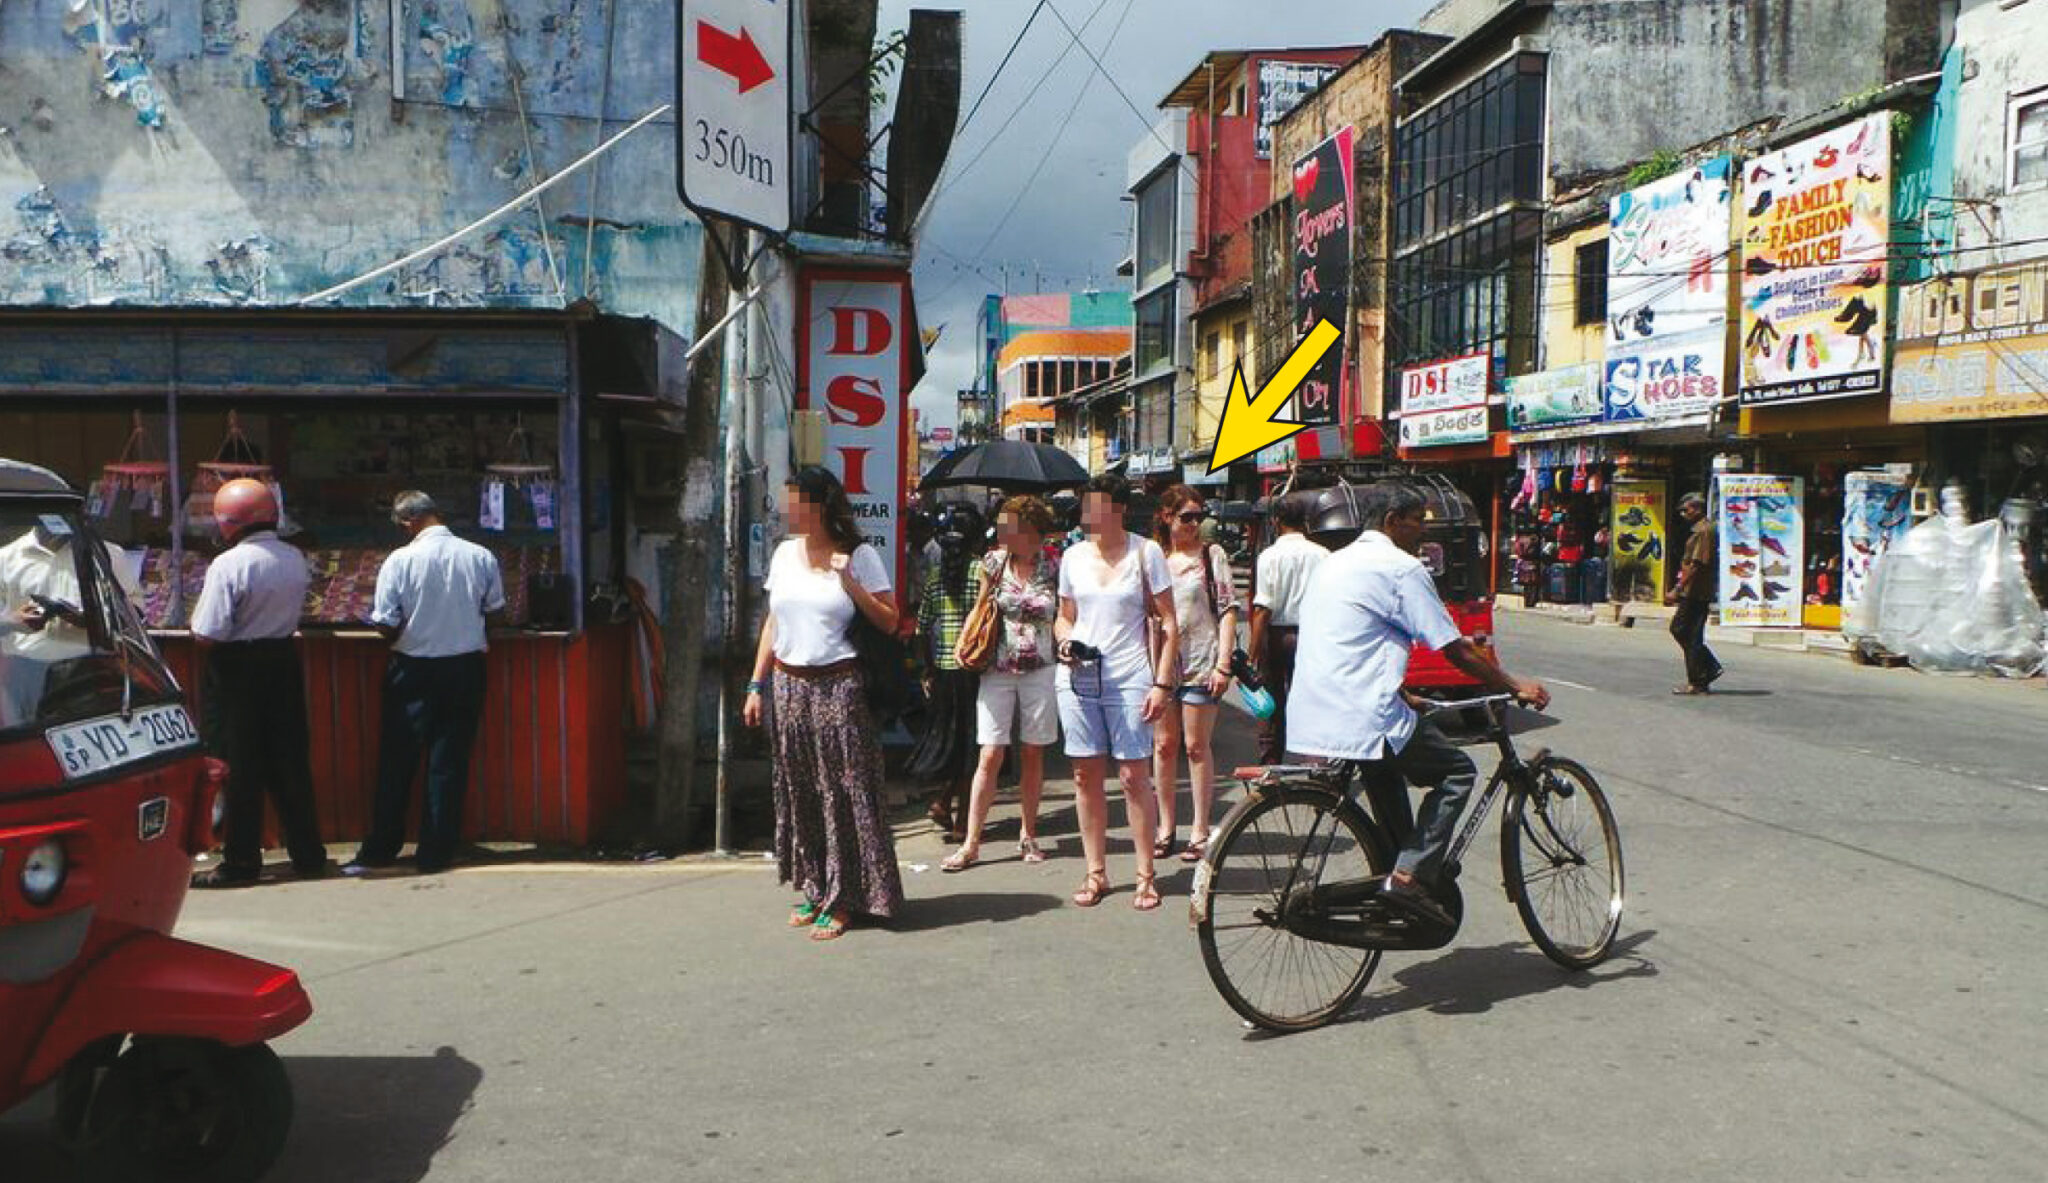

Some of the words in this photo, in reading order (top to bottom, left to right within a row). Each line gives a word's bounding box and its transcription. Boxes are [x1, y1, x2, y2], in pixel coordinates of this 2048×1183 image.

[695, 118, 775, 188] 350m
[1775, 178, 1849, 221] FAMILY
[1769, 204, 1854, 249] FASHION
[1777, 235, 1842, 271] TOUCH
[824, 306, 892, 495] DSI
[1408, 367, 1449, 400] DSI
[64, 747, 91, 772] SP
